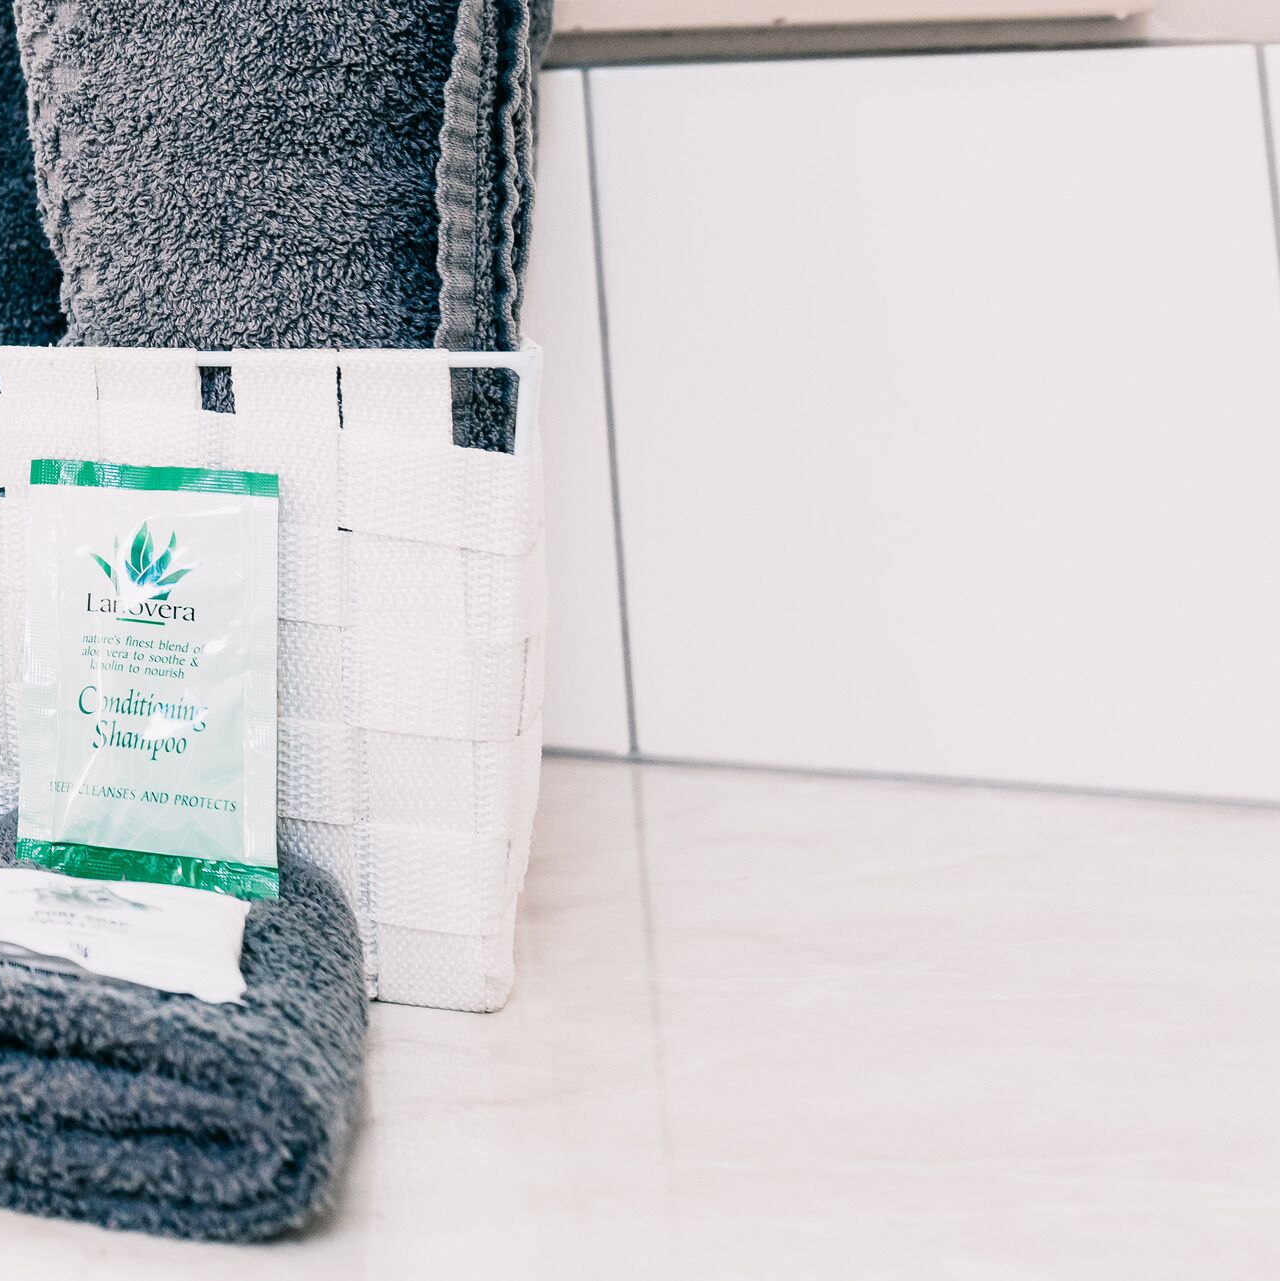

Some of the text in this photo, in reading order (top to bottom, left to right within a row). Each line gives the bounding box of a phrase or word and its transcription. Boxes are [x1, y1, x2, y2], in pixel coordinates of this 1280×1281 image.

[125, 635, 154, 649] finest
[158, 639, 190, 653] blend
[106, 649, 129, 660] vera
[133, 651, 145, 661] to
[148, 654, 186, 666] soothe
[190, 657, 199, 668] &
[128, 663, 140, 674] to
[144, 665, 185, 680] nourish
[92, 719, 188, 761] Shampoo
[78, 783, 137, 801] CLEANSES
[140, 790, 169, 804] AND
[174, 793, 238, 813] PROTECTS
